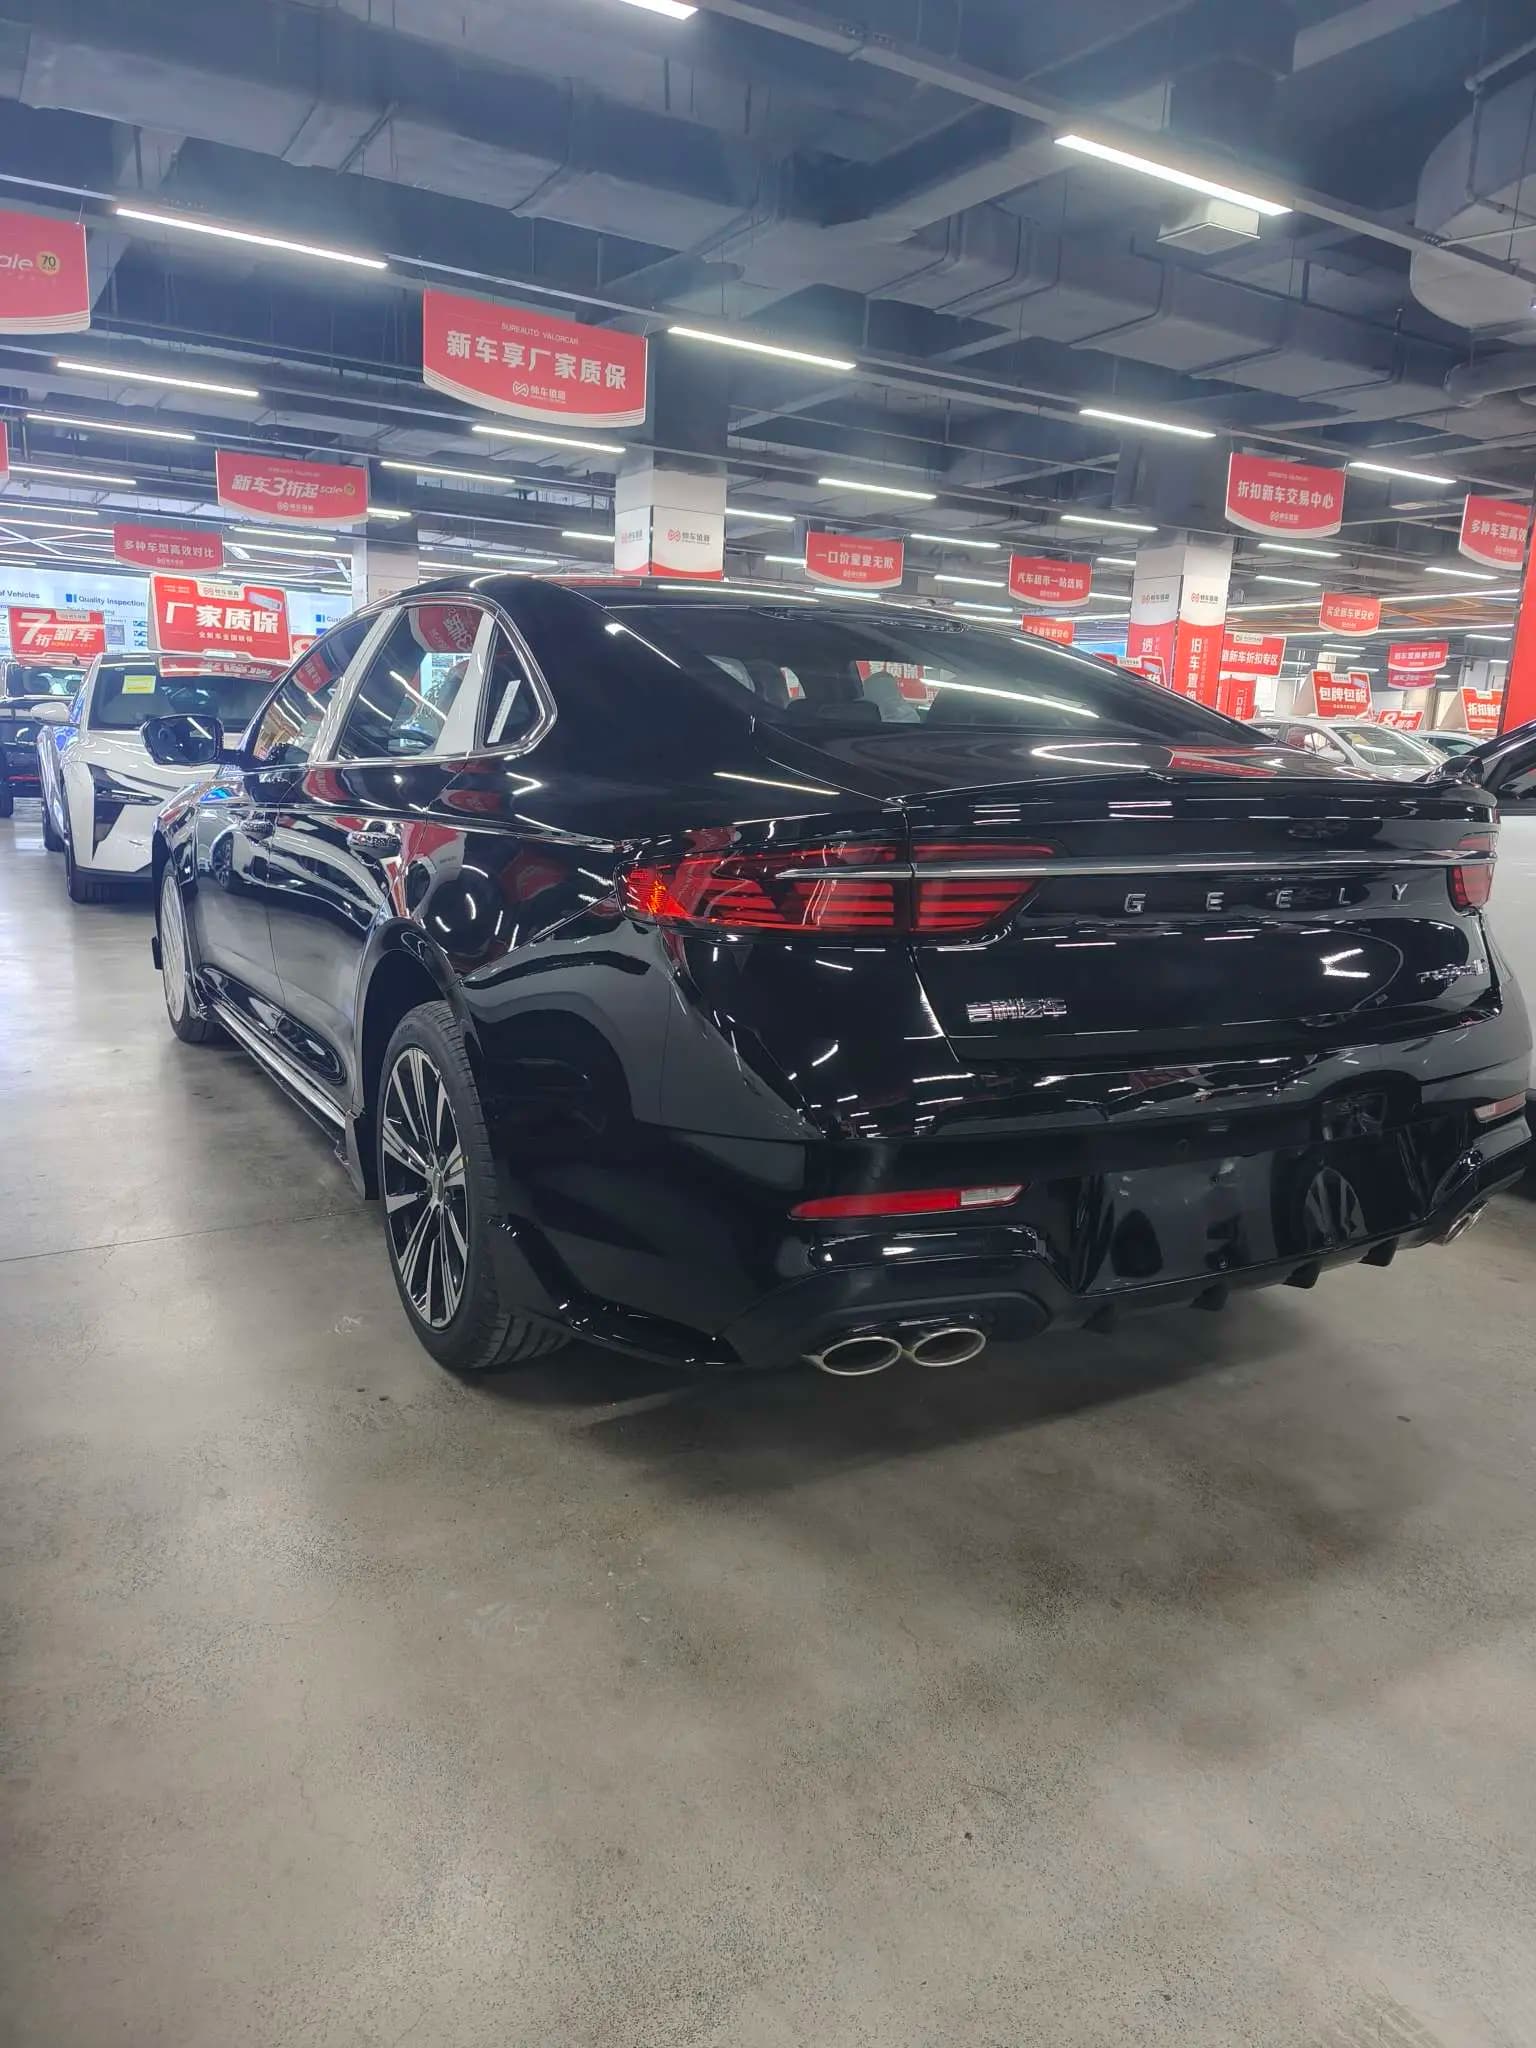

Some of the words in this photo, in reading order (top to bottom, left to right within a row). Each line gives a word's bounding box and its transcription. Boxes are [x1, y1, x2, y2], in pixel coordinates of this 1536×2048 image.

[446, 330, 626, 390] 新车享厂家质保
[231, 473, 319, 499] 新车3折起
[1238, 480, 1334, 508] 折扣新车交易中心
[124, 540, 214, 558] 多种车型高效对比
[8, 591, 40, 599] Vehicles
[78, 596, 104, 605] Quality
[107, 598, 145, 607] Inspection
[166, 602, 279, 634] 厂家质保
[1320, 686, 1367, 704] 包牌包税
[1124, 883, 1408, 913] GEELY
